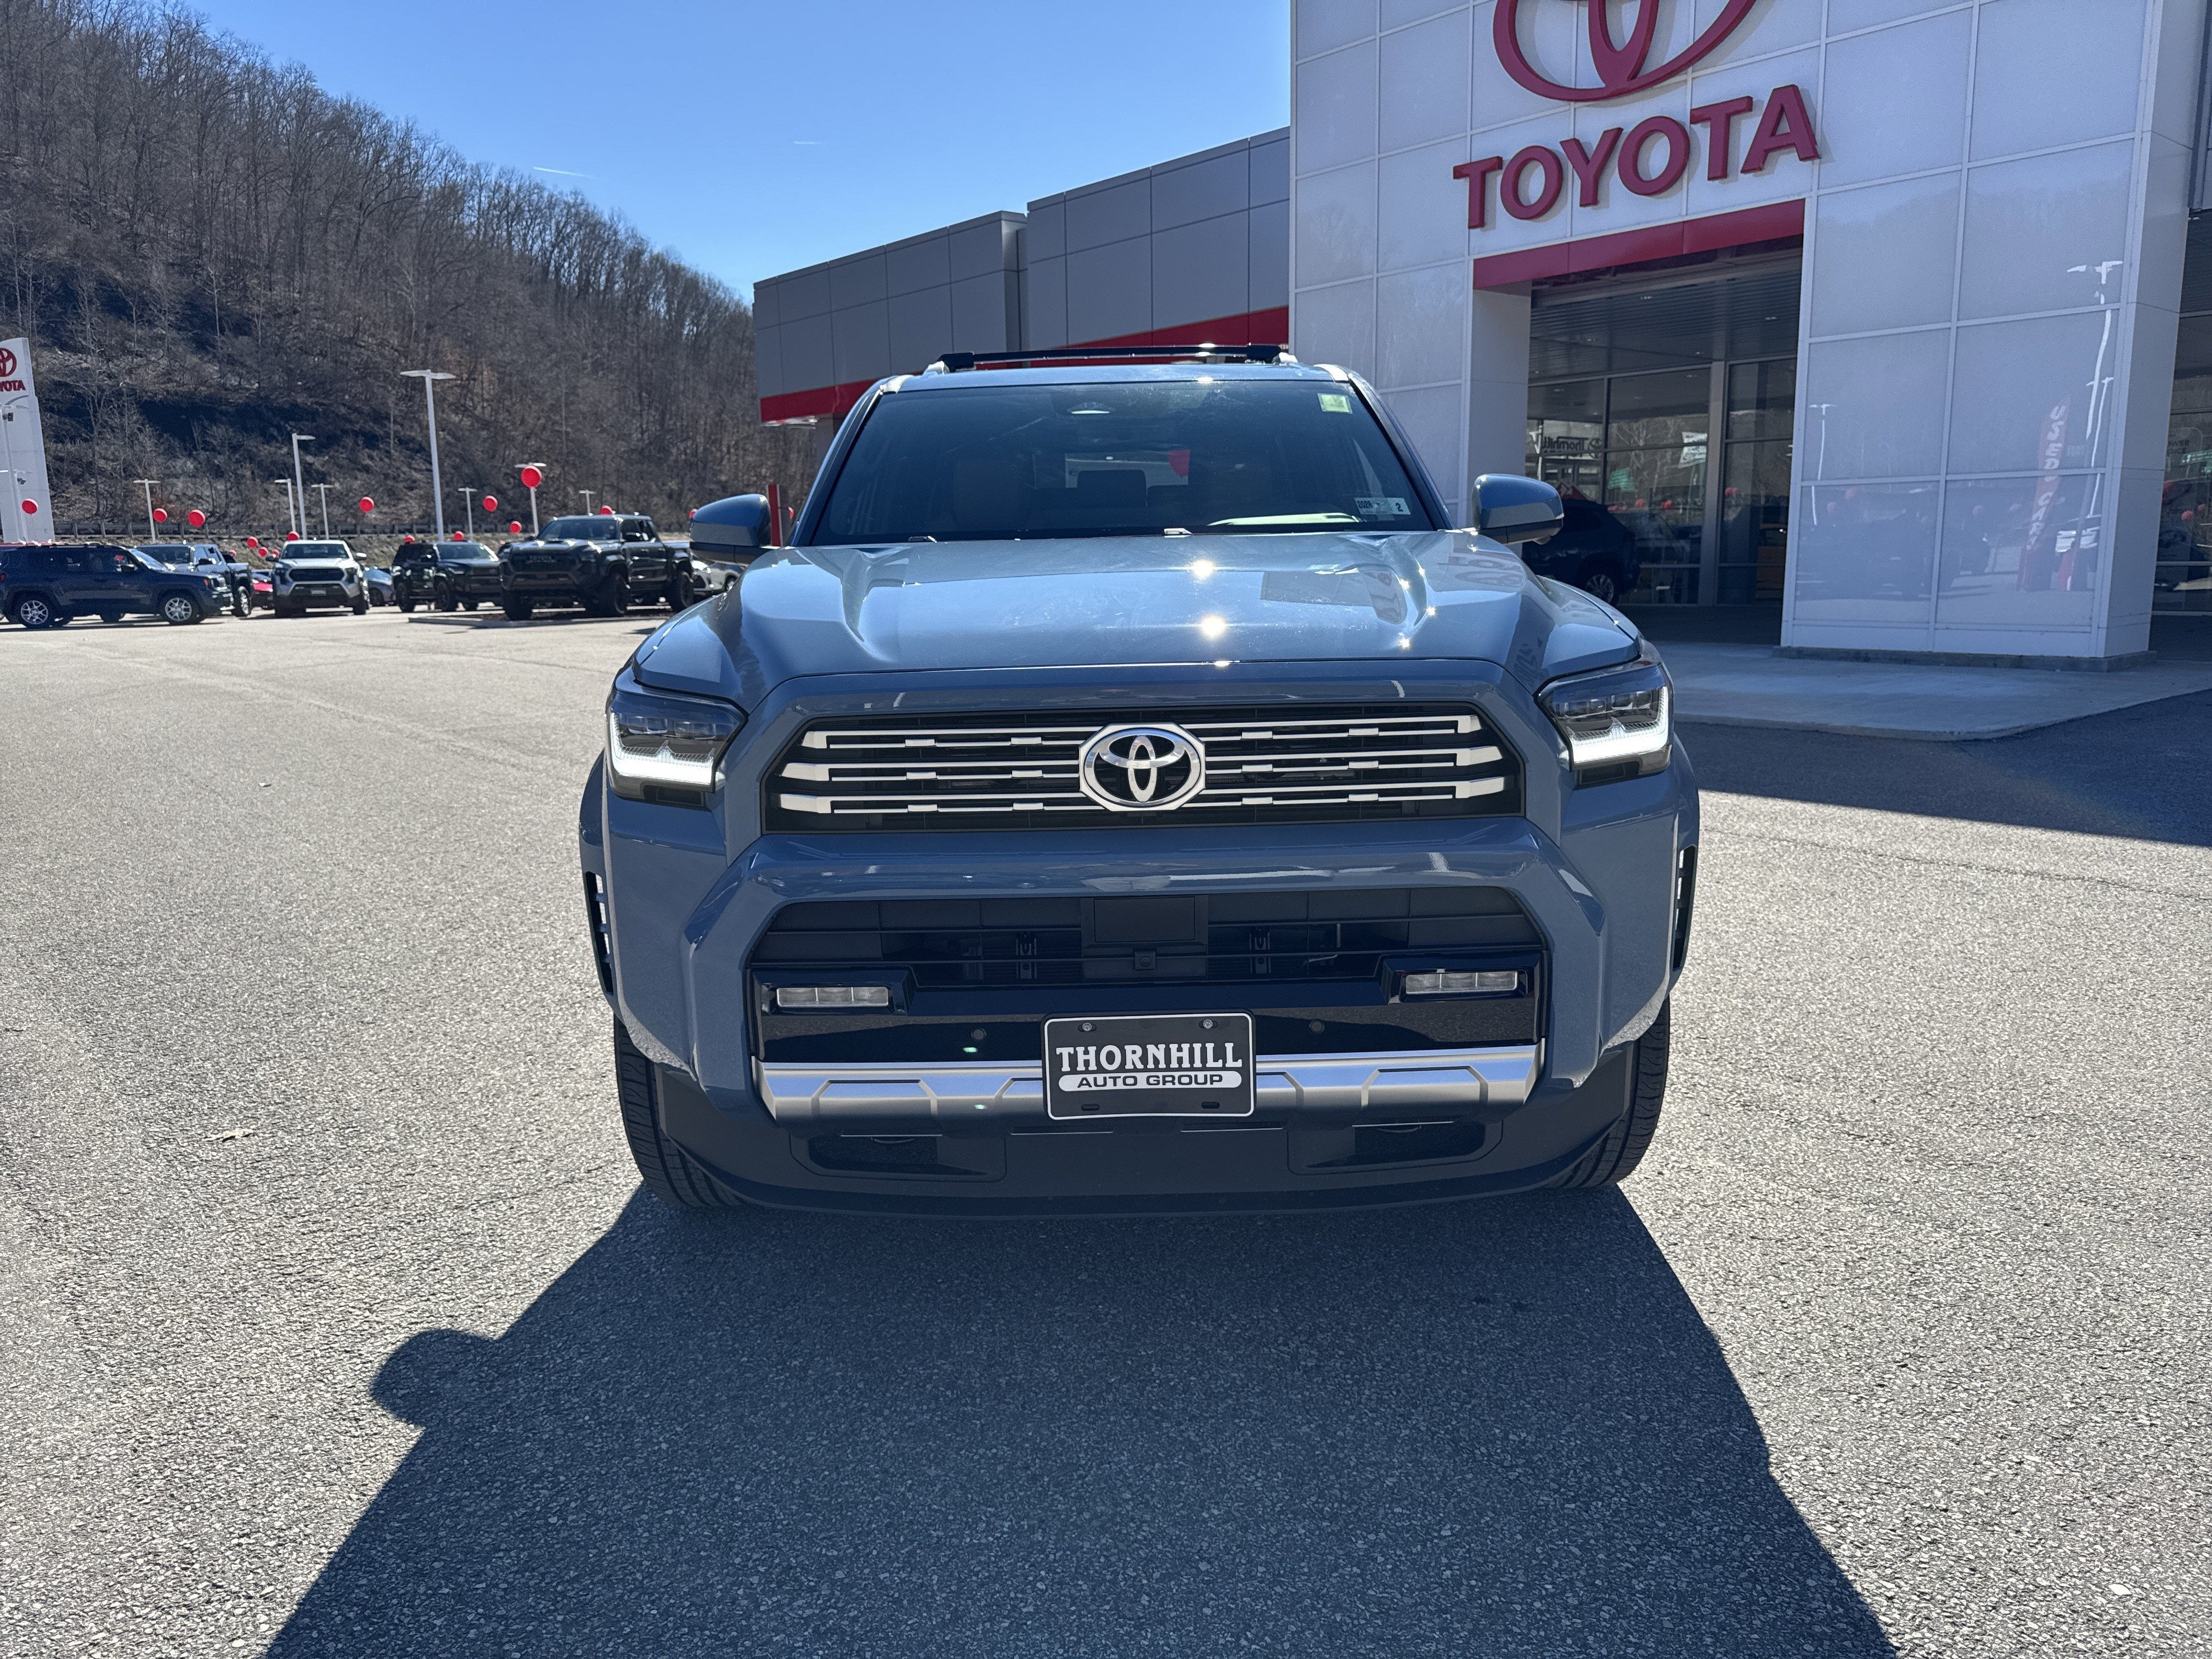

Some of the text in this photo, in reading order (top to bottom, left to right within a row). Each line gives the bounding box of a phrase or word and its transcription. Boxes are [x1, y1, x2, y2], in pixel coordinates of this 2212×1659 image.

[1453, 84, 1820, 229] TOYOTA
[1395, 503, 1403, 512] 2
[1056, 1042, 1242, 1072] THORNHILL
[1077, 1074, 1223, 1088] AUTO GROUP
